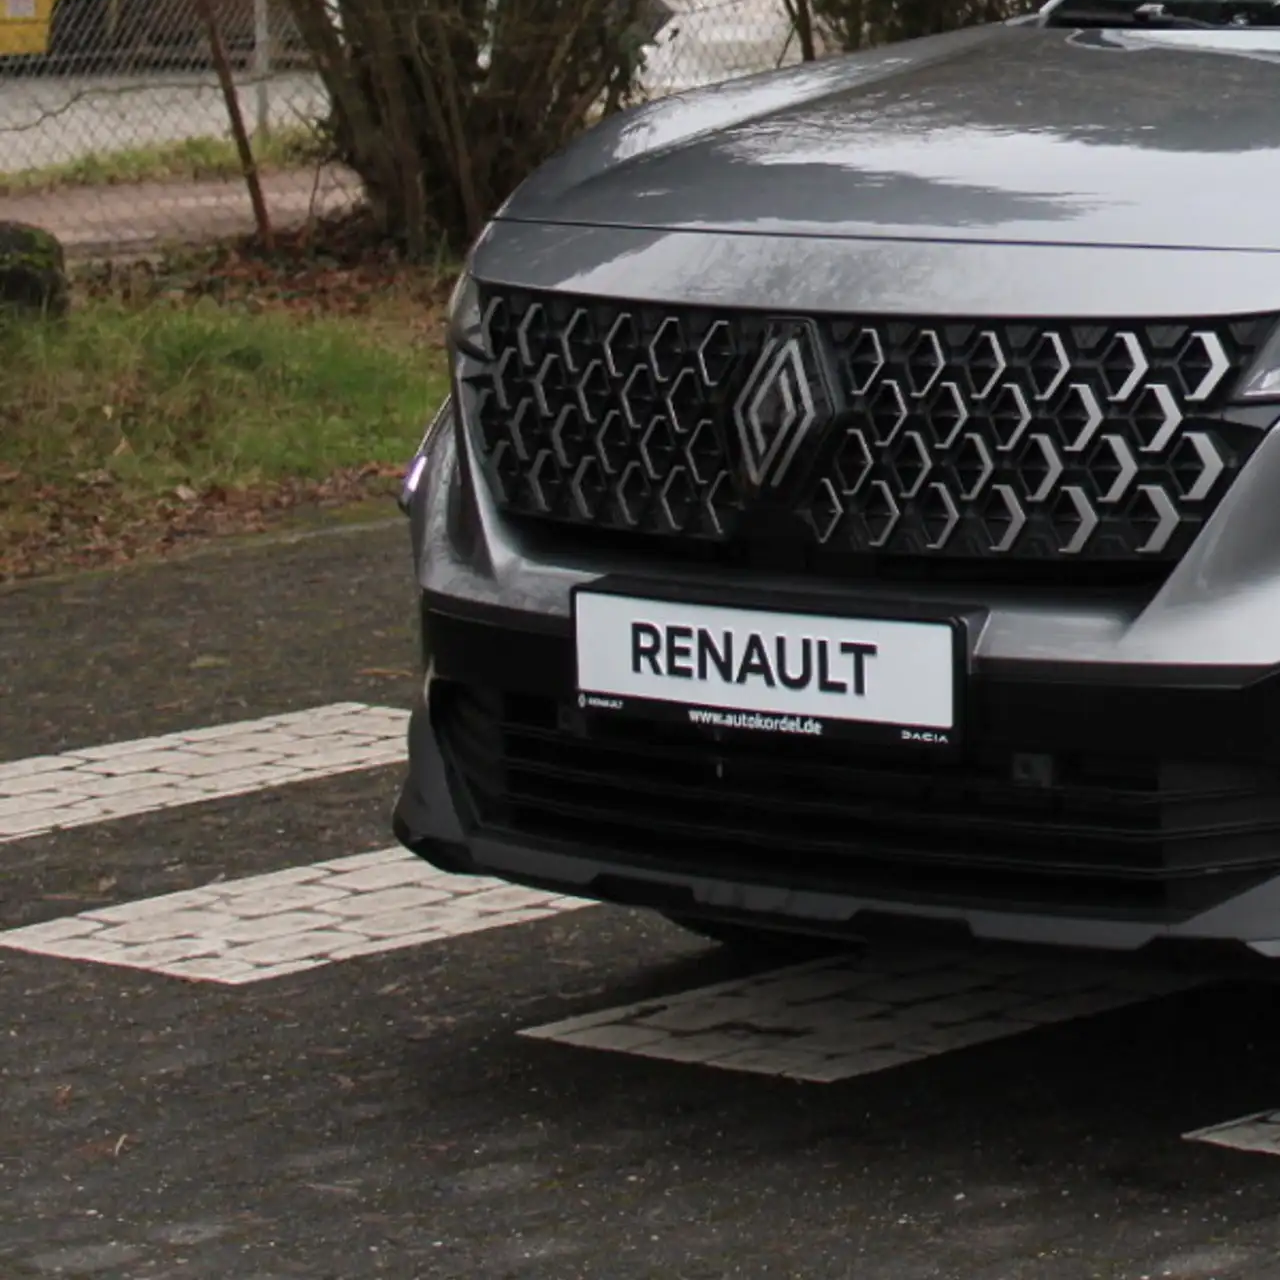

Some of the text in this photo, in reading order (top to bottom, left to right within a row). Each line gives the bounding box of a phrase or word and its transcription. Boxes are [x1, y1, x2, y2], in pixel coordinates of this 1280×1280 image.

[631, 621, 877, 697] RENAULT
[688, 710, 823, 736] www.autokordel.de
[901, 730, 949, 744] DACIA
